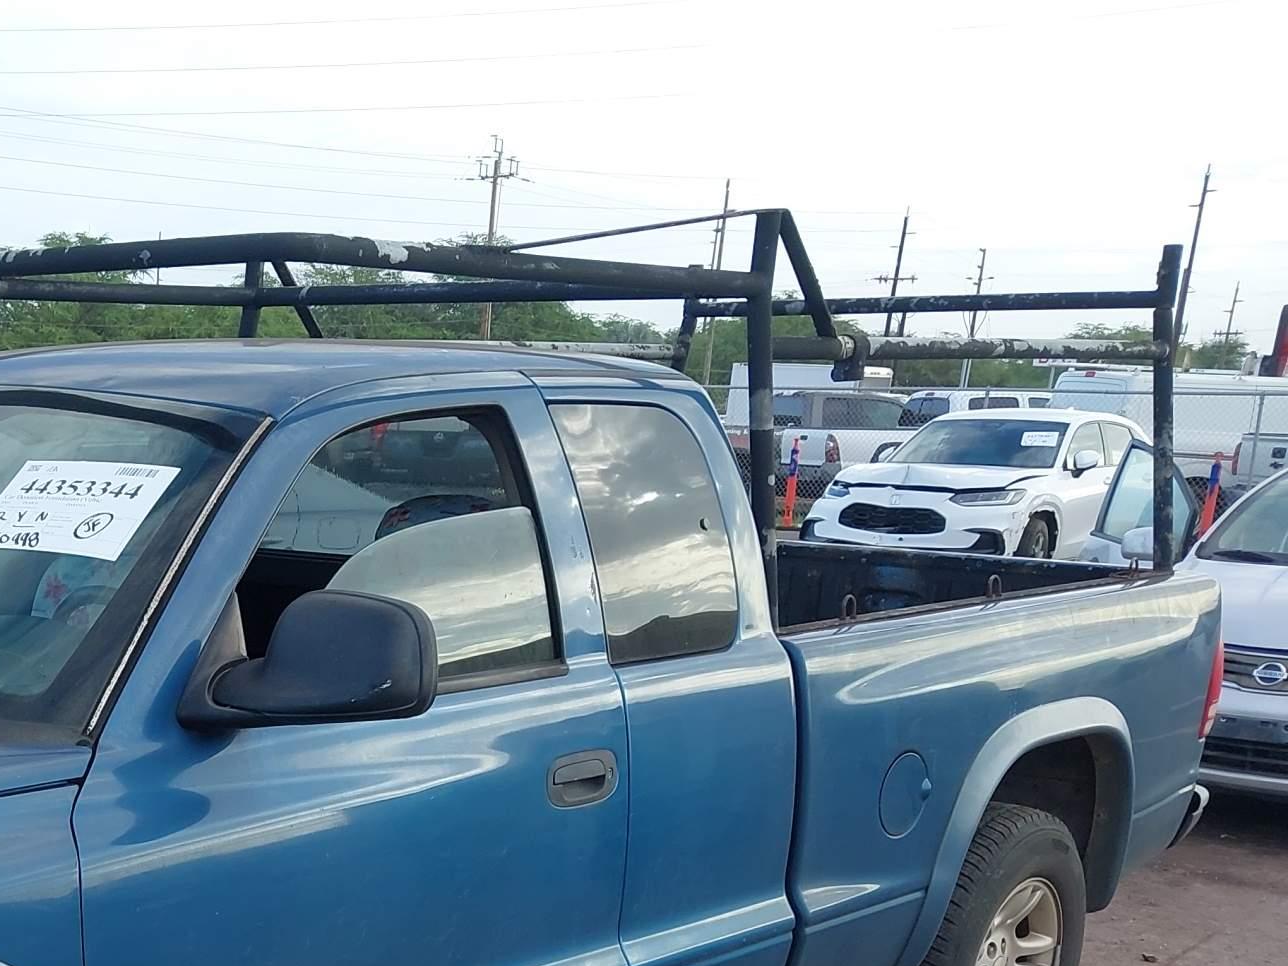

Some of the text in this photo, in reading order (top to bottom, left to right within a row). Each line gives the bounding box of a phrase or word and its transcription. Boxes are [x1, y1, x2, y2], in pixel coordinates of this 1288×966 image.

[20, 479, 144, 499] 44353344
[17, 511, 28, 522] Y
[34, 511, 49, 522] N
